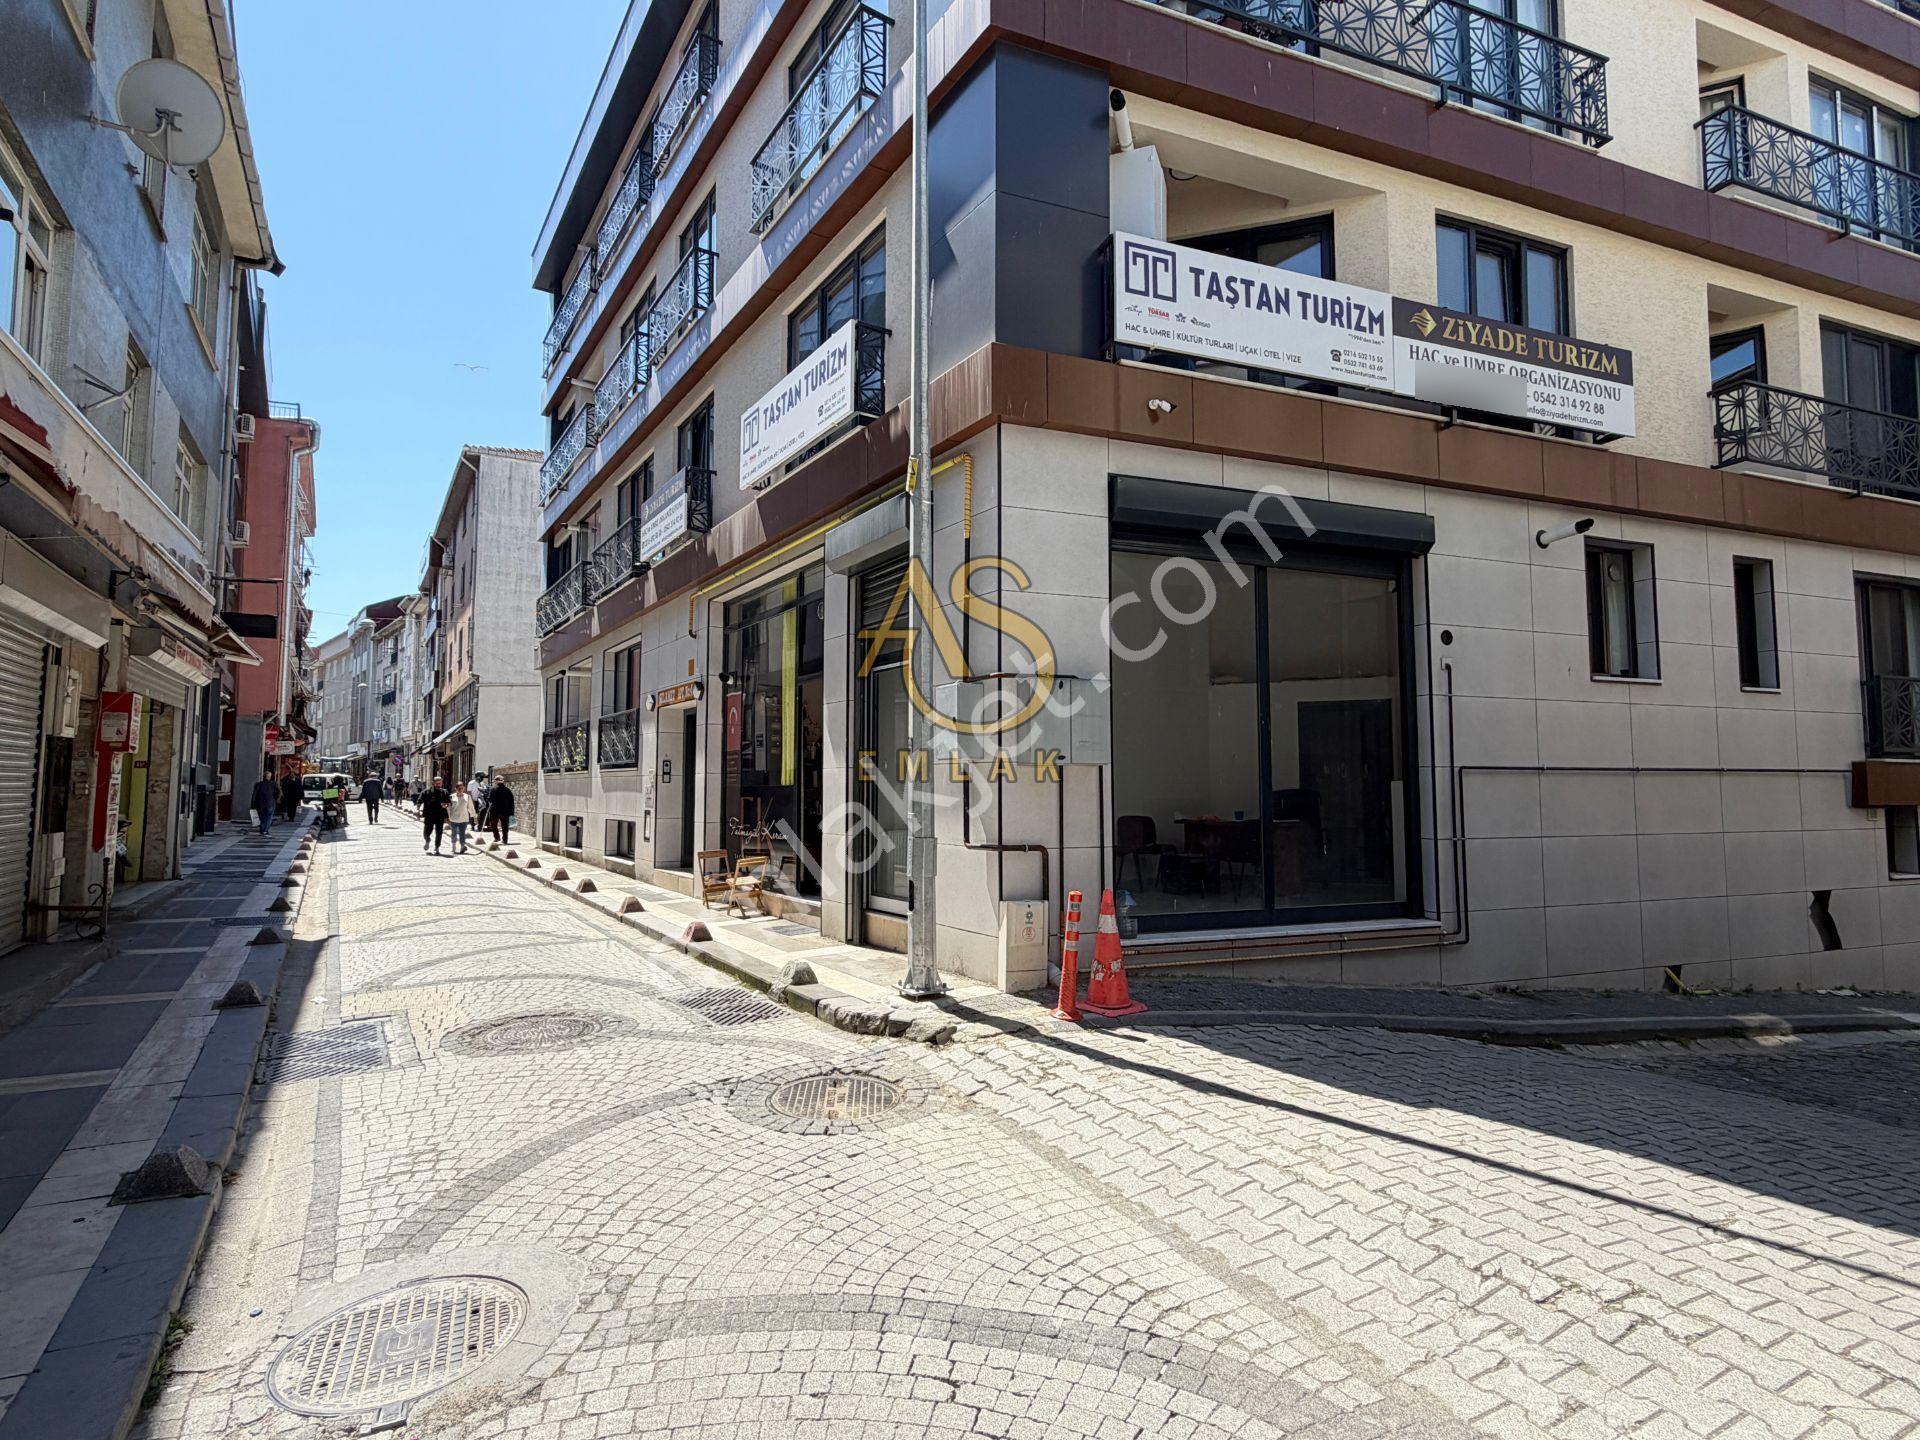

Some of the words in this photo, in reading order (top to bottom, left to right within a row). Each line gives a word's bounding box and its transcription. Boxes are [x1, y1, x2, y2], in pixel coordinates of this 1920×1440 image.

[1189, 265, 1291, 317] TAŞTAN
[1297, 290, 1385, 337] TURİZM
[1125, 322, 1141, 333] HAC
[1150, 328, 1171, 339] UMRE
[1176, 332, 1203, 345] KÜLTÜR
[1204, 337, 1234, 350] TURLARI
[1239, 345, 1258, 356] UÇAK
[1263, 349, 1281, 360] OTEL
[762, 379, 802, 431] TAŞTAN
[803, 340, 848, 397] TURİZM
[1509, 366, 1622, 402] ORGANİZASYONU
[1533, 390, 1557, 406] 0542
[1560, 395, 1578, 410] 314
[1579, 399, 1591, 412] 92
[1593, 402, 1605, 415] 88
